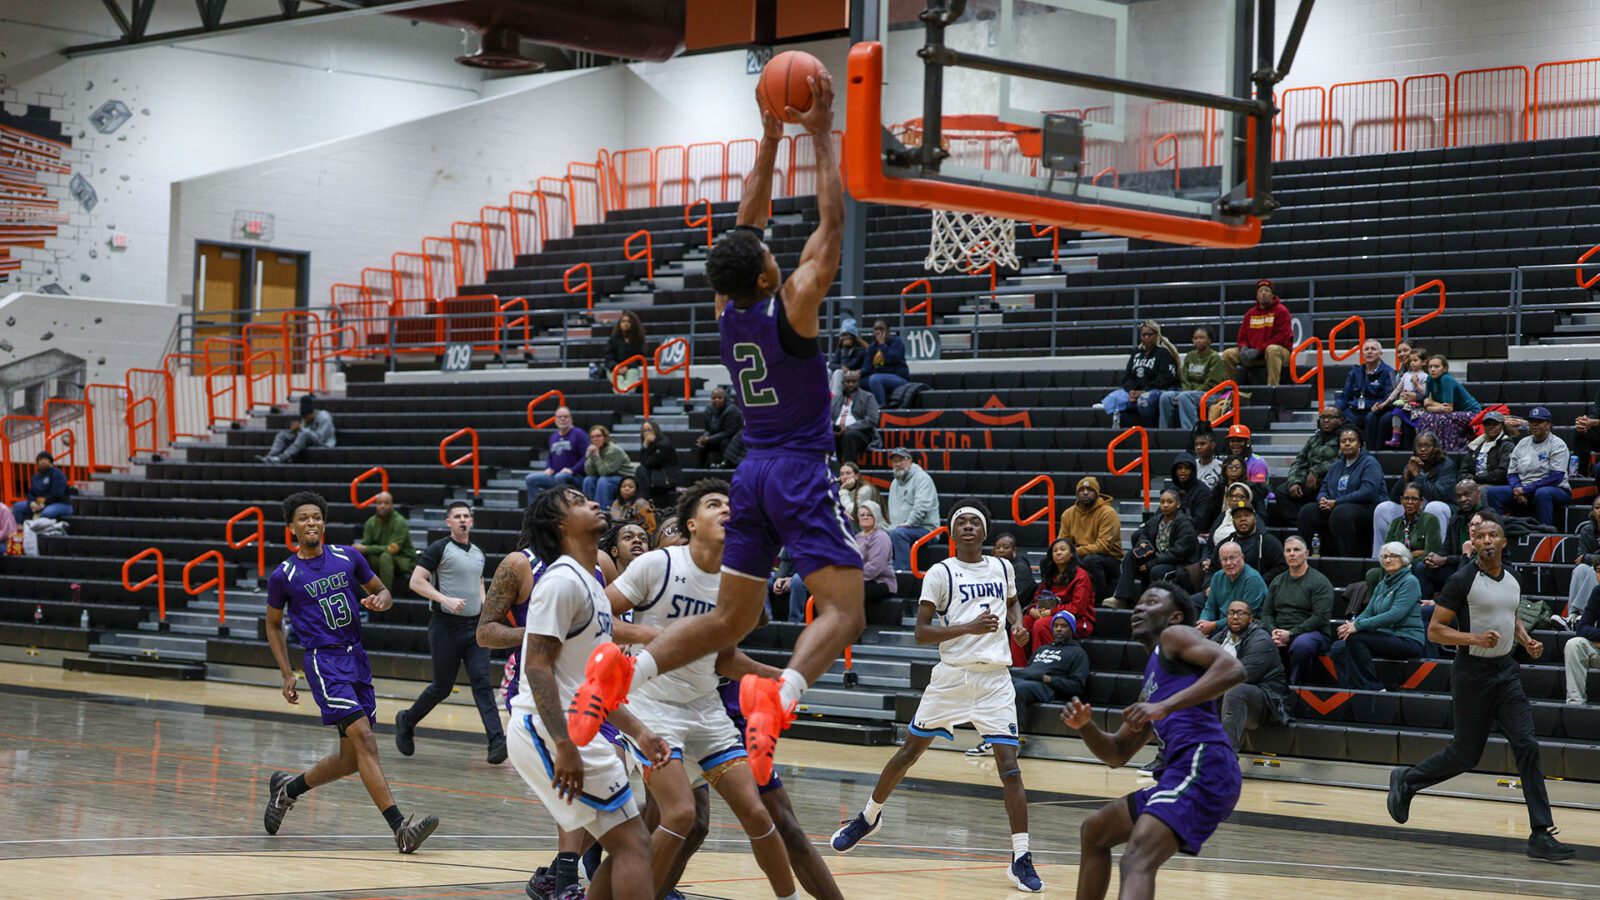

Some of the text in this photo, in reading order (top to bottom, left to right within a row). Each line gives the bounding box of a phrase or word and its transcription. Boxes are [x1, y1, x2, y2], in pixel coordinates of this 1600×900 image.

[447, 345, 470, 369] 109
[907, 330, 936, 358] 110
[733, 342, 779, 407] 2
[304, 571, 348, 597] VPCC
[958, 581, 1004, 603] STORM
[318, 592, 352, 630] 13
[667, 594, 716, 619] STO
